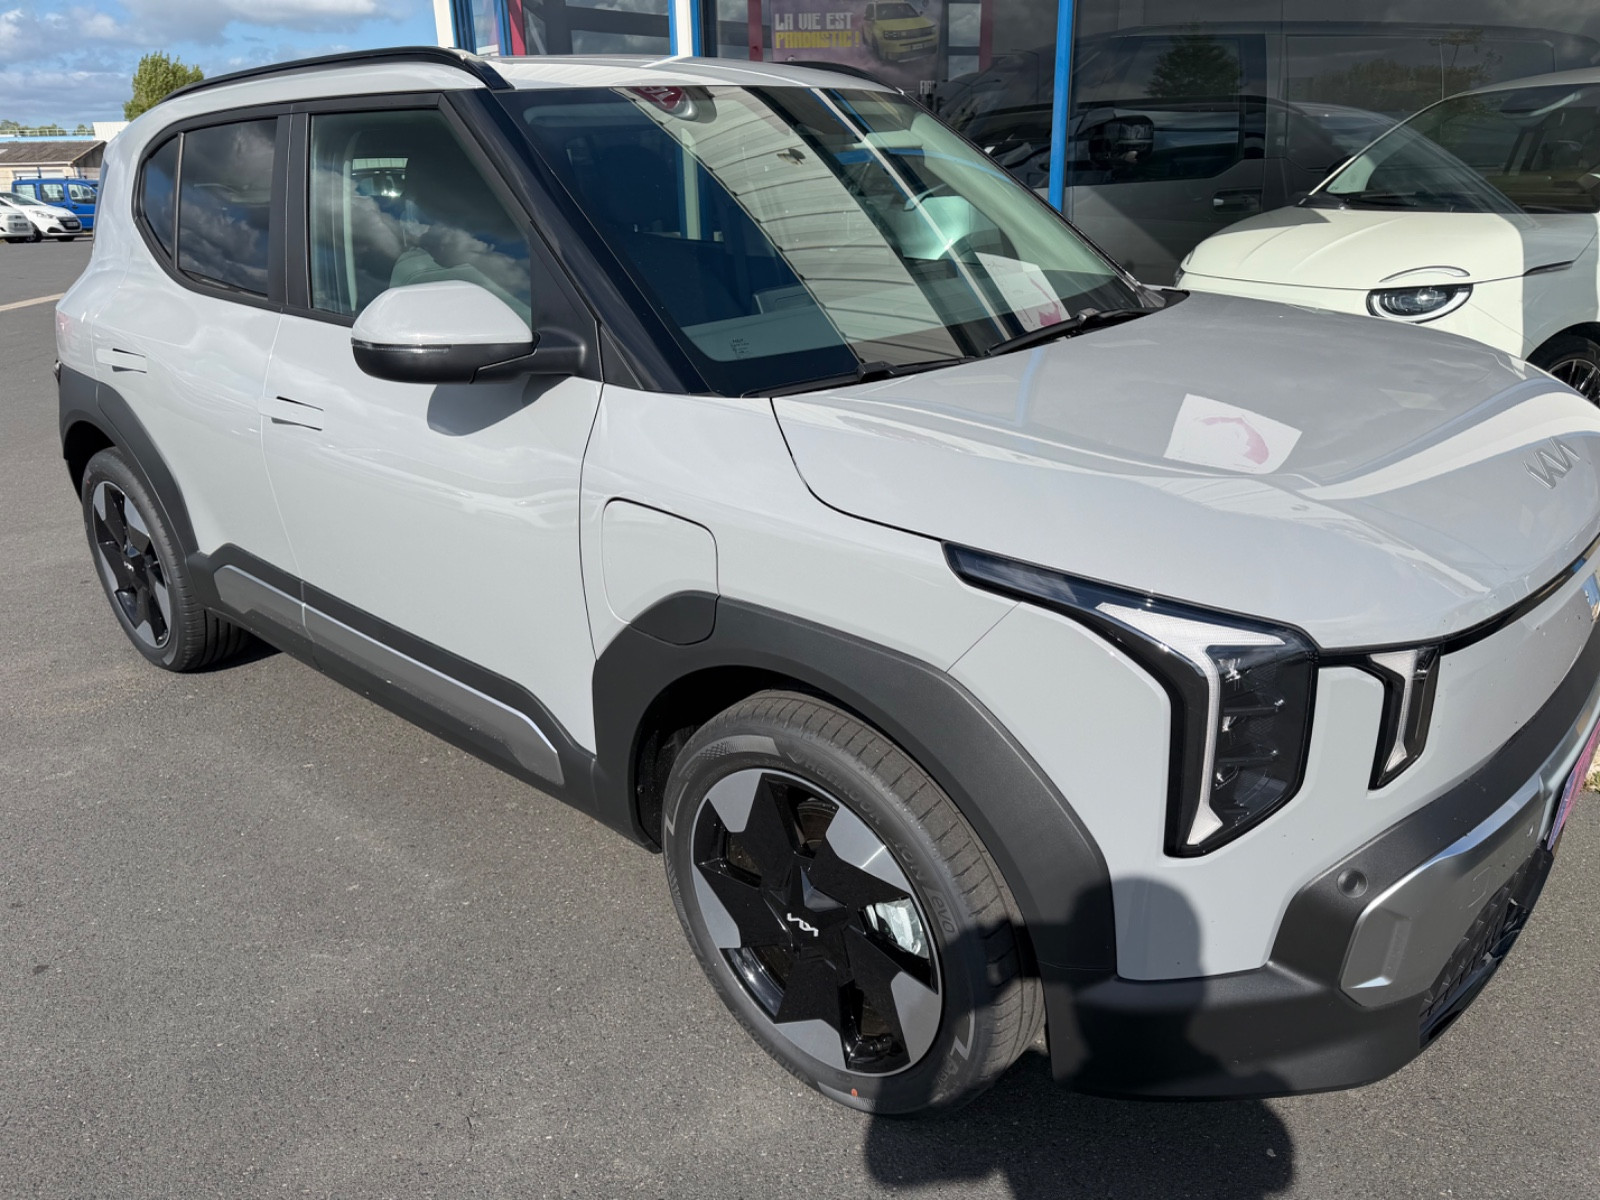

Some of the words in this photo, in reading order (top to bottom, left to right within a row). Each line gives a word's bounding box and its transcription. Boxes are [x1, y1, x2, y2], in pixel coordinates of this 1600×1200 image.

[775, 13, 793, 30] LA
[798, 12, 821, 30] VIE
[826, 12, 853, 29] EST
